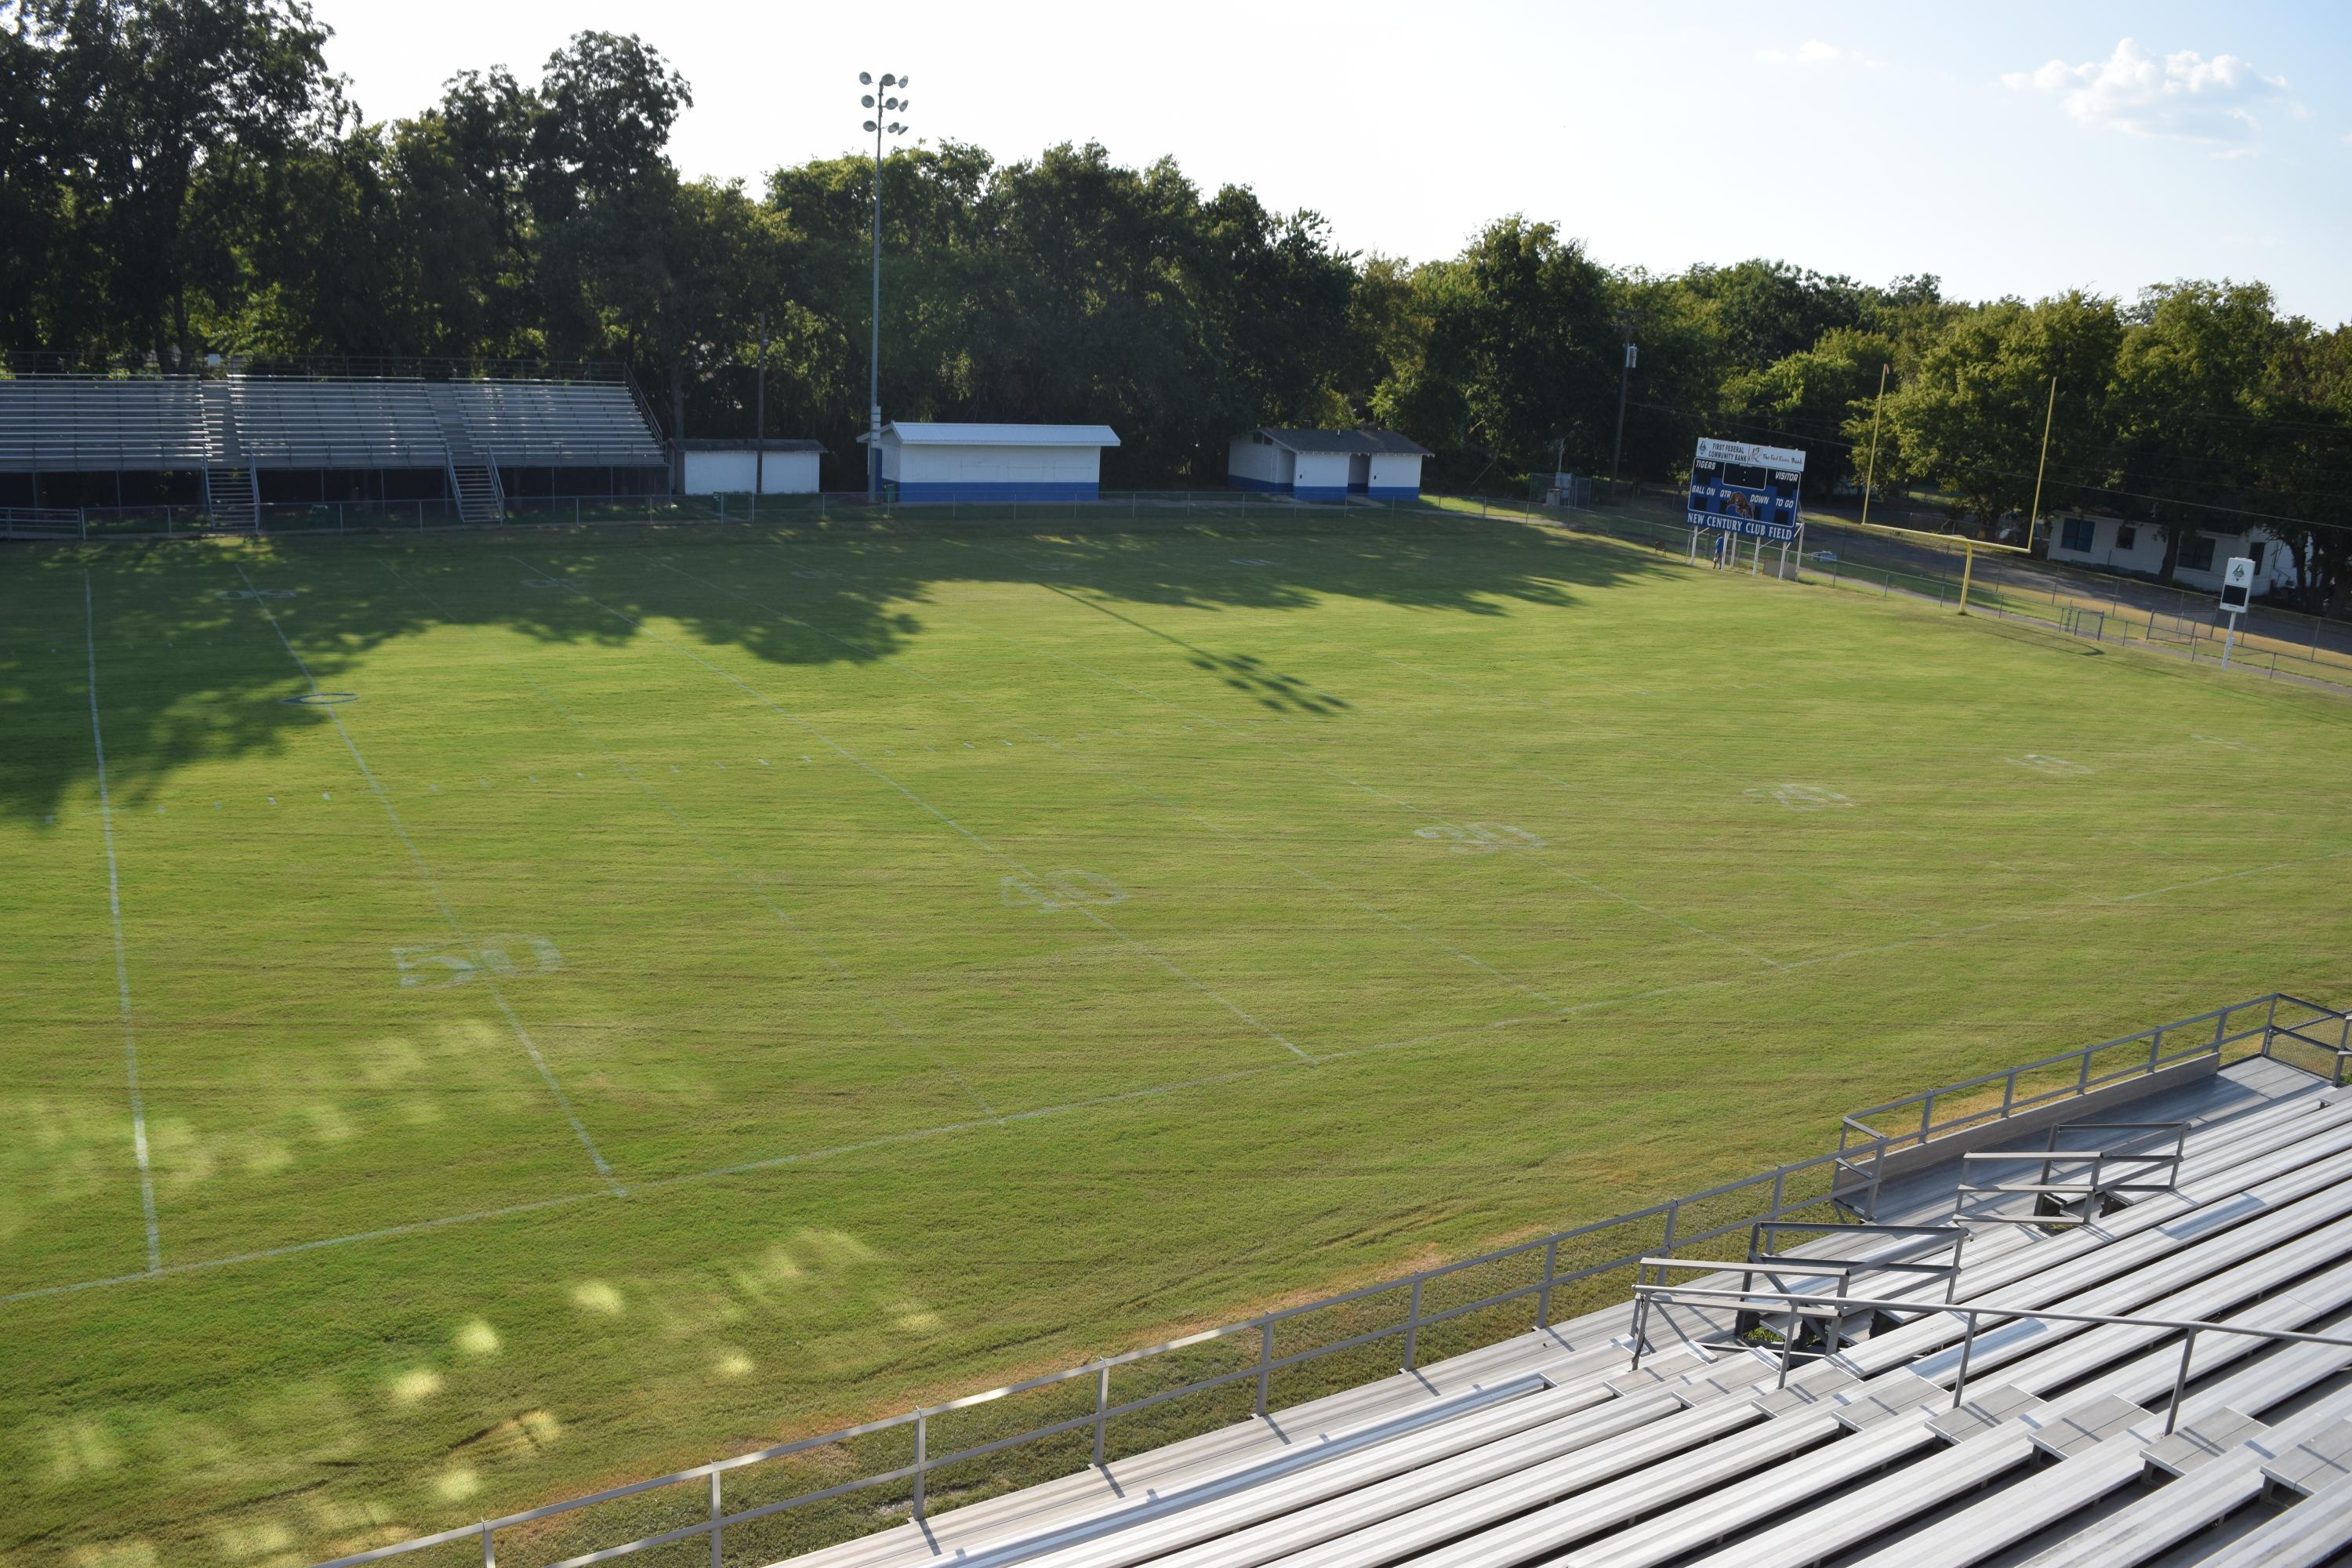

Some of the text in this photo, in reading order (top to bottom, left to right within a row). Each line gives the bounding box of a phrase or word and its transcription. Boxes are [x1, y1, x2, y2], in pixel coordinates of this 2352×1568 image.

[1712, 443, 1744, 454] FIRST FEDERAL
[1708, 450, 1748, 463] COMMUNITY BANK
[1696, 459, 1716, 470] TIGERS
[1775, 470, 1798, 482] VISITOR
[1692, 485, 1716, 496] BALL ON
[1719, 489, 1732, 499] QTR
[1750, 494, 1769, 505] DOWN
[1776, 498, 1794, 508] TO GO
[1687, 512, 1792, 540] NEW CENTURY CLUB FIELD
[390, 931, 564, 991] 50
